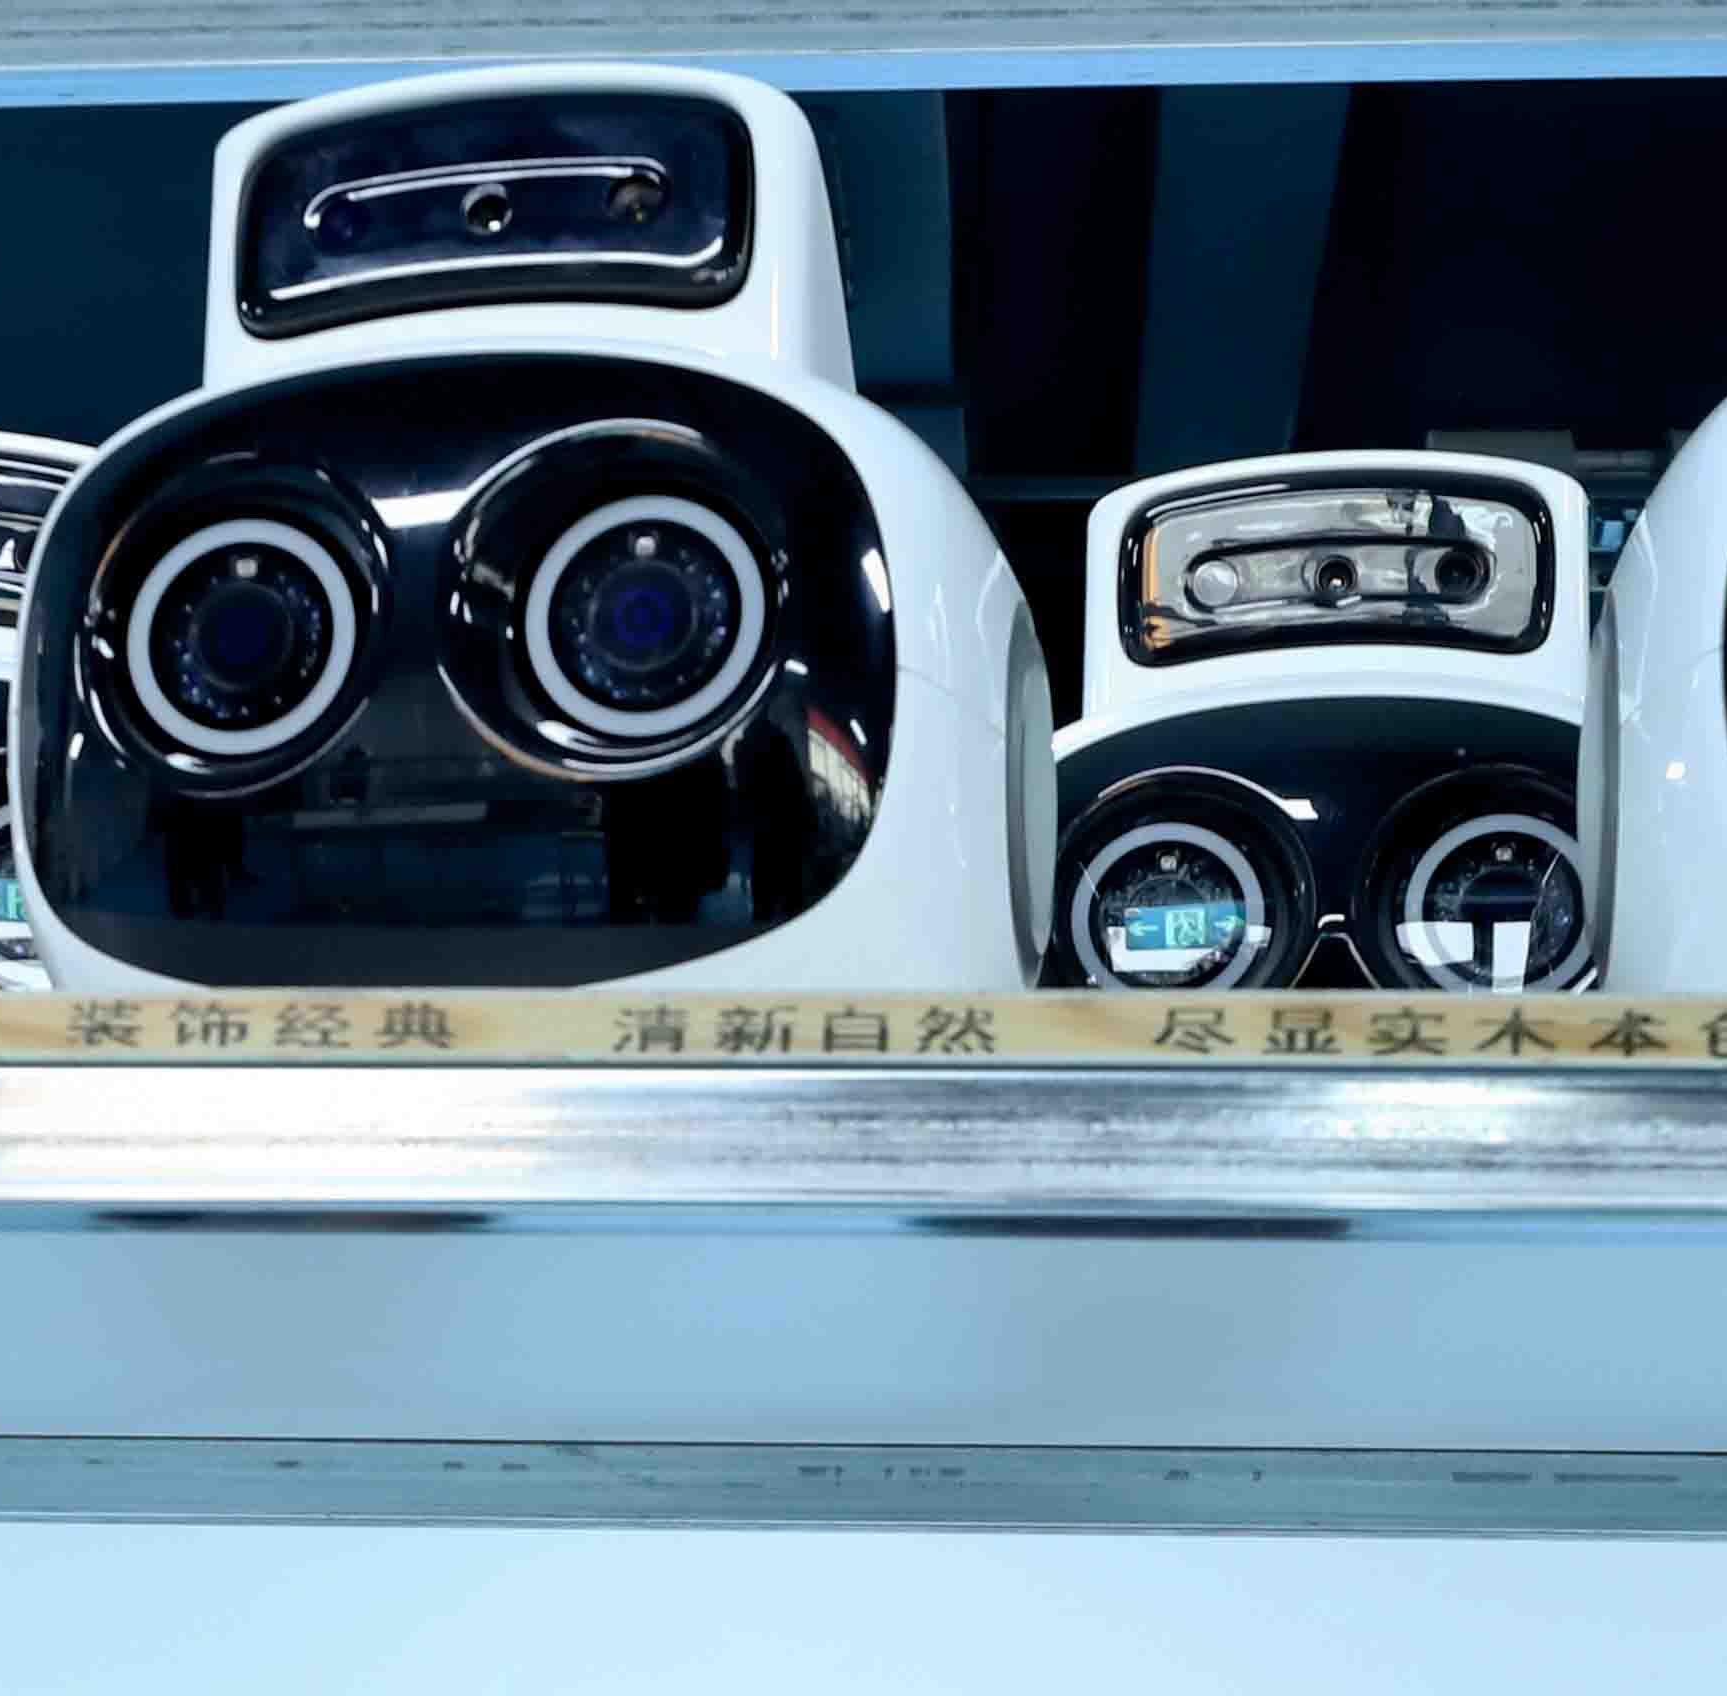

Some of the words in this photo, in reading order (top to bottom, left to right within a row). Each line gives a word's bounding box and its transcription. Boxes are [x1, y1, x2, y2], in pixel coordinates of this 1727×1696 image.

[65, 1001, 458, 1049] 装饰经典
[611, 1003, 997, 1054] 清新自然
